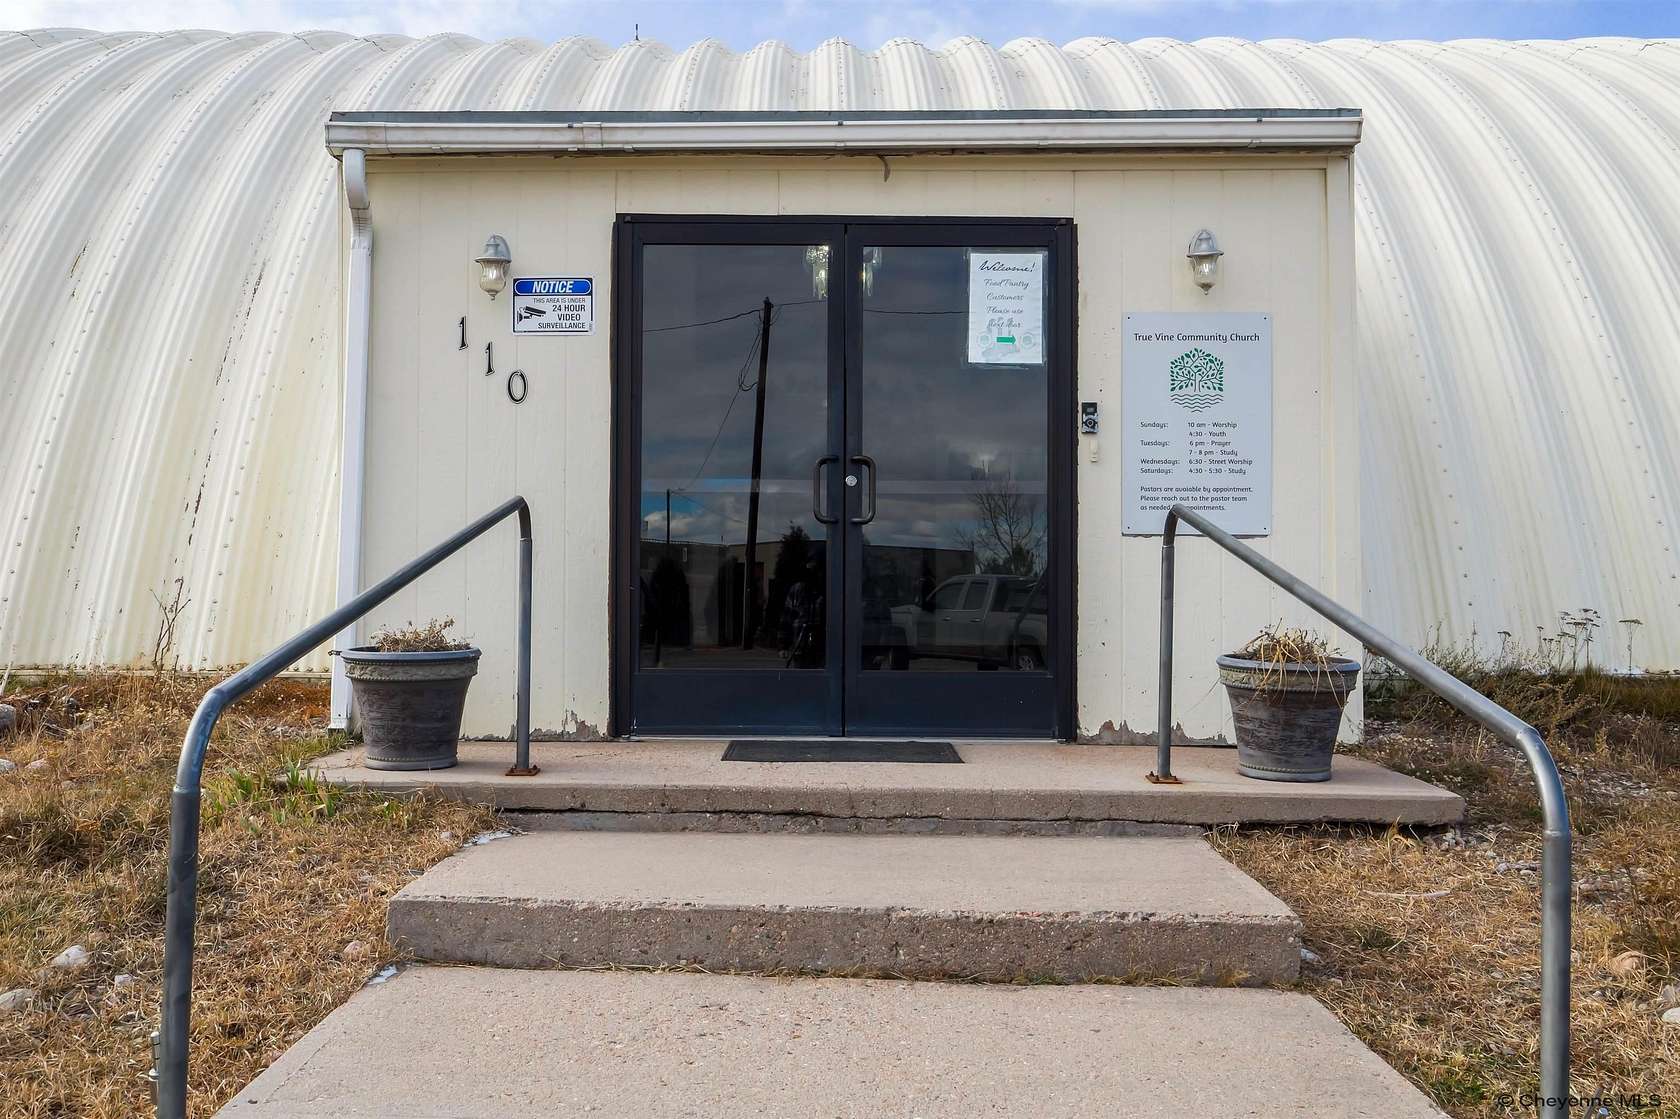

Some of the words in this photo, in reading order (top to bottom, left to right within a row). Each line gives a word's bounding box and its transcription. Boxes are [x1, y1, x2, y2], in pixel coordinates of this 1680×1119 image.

[979, 260, 1036, 273] Welcome!
[532, 281, 574, 293] NOTICE
[984, 279, 1003, 287] Food
[1003, 279, 1030, 290] Pantry
[986, 292, 1024, 301] Customers
[564, 304, 586, 312] HOUR
[987, 306, 1009, 314] Please
[557, 313, 581, 321] VIDEO
[1134, 333, 1153, 342] True
[1155, 333, 1175, 342] Vine
[1176, 333, 1227, 343] Community
[1230, 333, 1260, 342] Church
